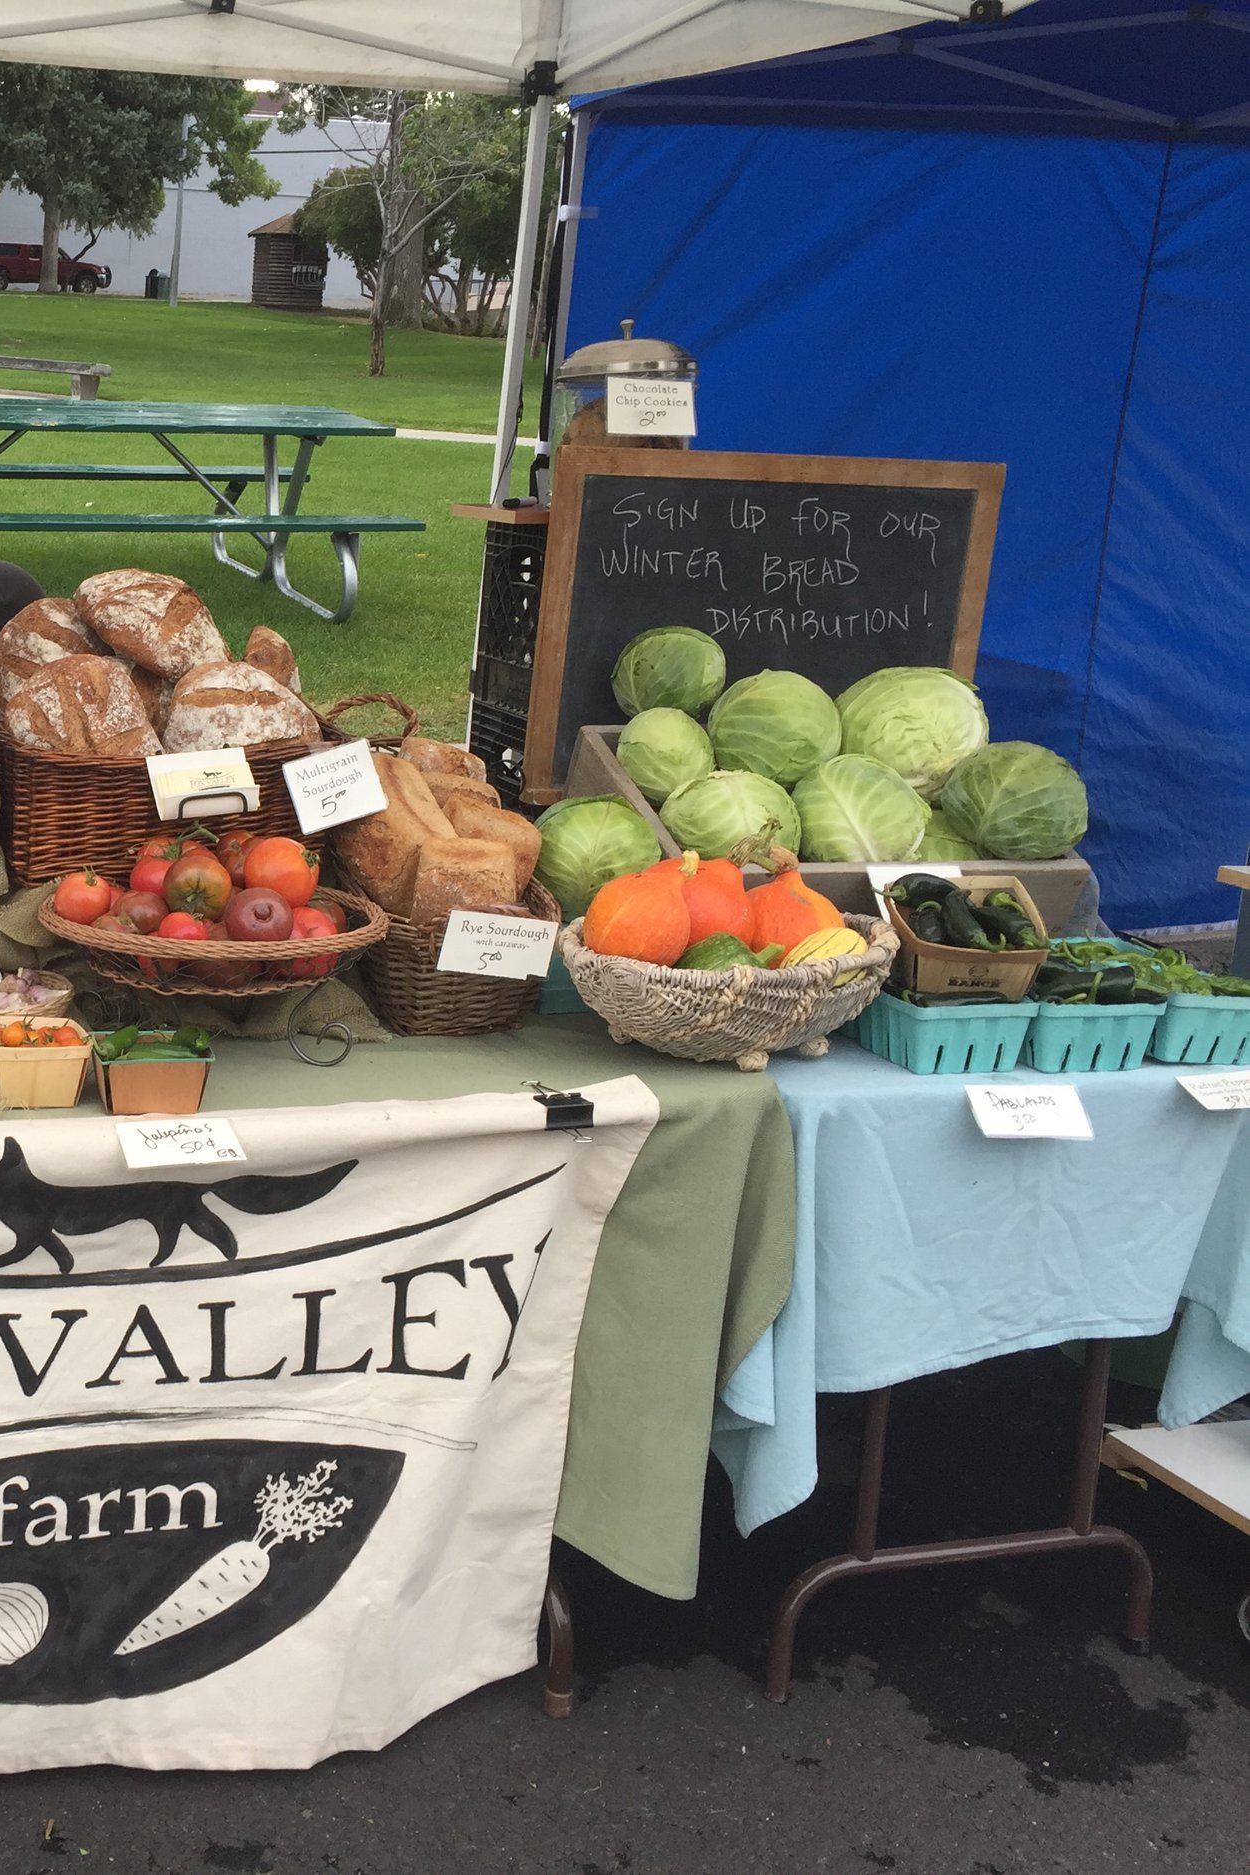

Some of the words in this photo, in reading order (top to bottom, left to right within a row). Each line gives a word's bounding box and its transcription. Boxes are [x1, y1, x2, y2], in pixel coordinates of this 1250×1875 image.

[615, 396, 641, 408] Chip
[643, 396, 688, 407] Cookies
[623, 383, 679, 394] Chocolate
[613, 492, 699, 532] SIGN
[730, 498, 766, 533] UP
[880, 511, 942, 567] OUR
[599, 524, 728, 591] WINTER
[762, 551, 860, 606] BREAD
[295, 753, 359, 783] Multigrain
[302, 768, 363, 799] Sourdough
[461, 920, 483, 935] Rye
[486, 922, 550, 941] Sourdough
